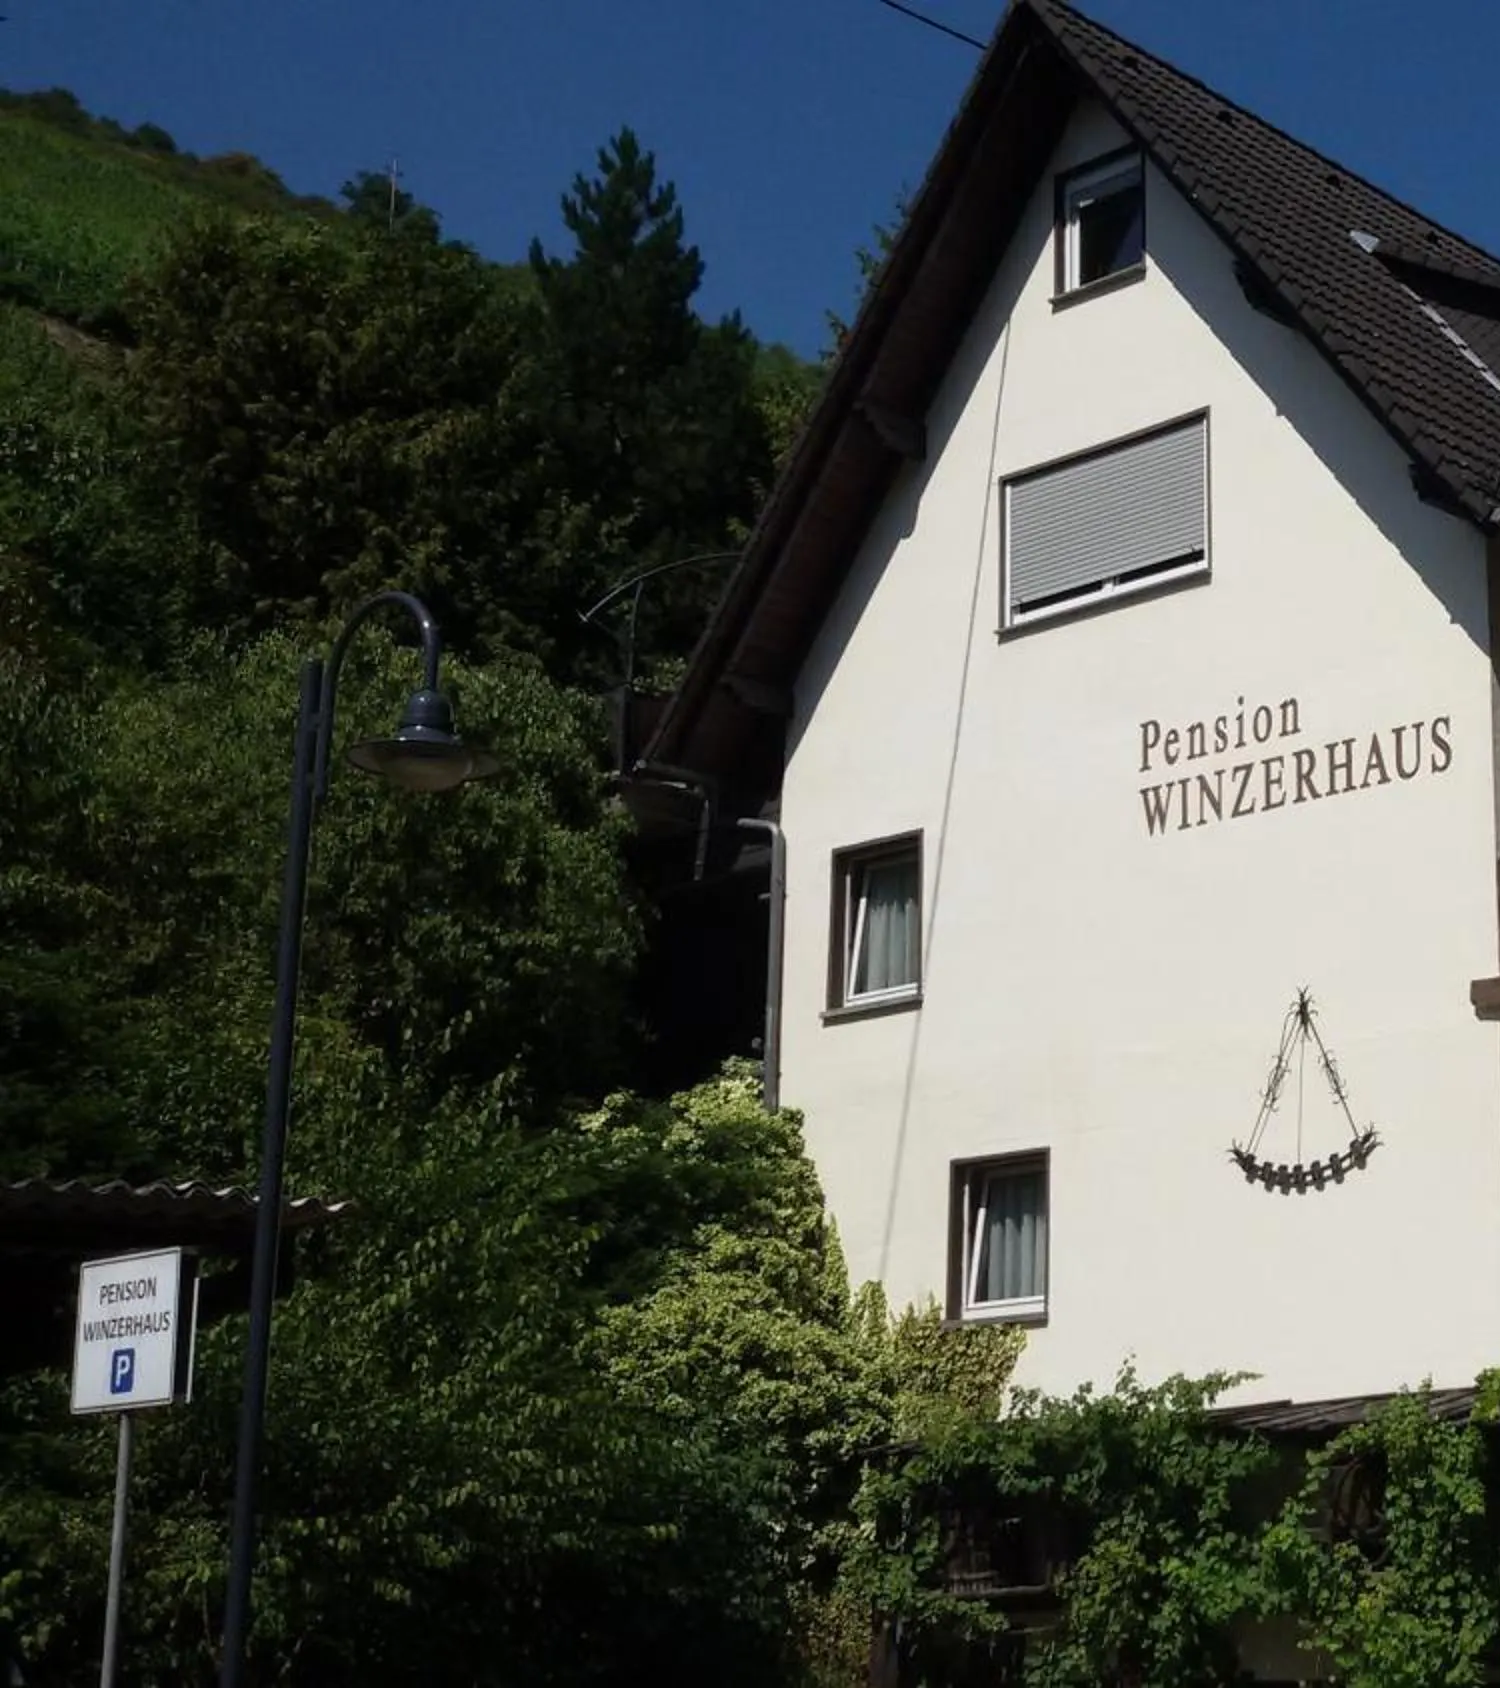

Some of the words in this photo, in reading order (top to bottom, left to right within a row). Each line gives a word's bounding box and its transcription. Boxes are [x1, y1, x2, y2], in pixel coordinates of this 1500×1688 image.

[1138, 695, 1302, 773] Pension
[1139, 715, 1454, 838] WINZERHAUS
[99, 1277, 157, 1306] PENSION
[83, 1311, 171, 1343] WINZERHAUS
[116, 1355, 130, 1387] P
